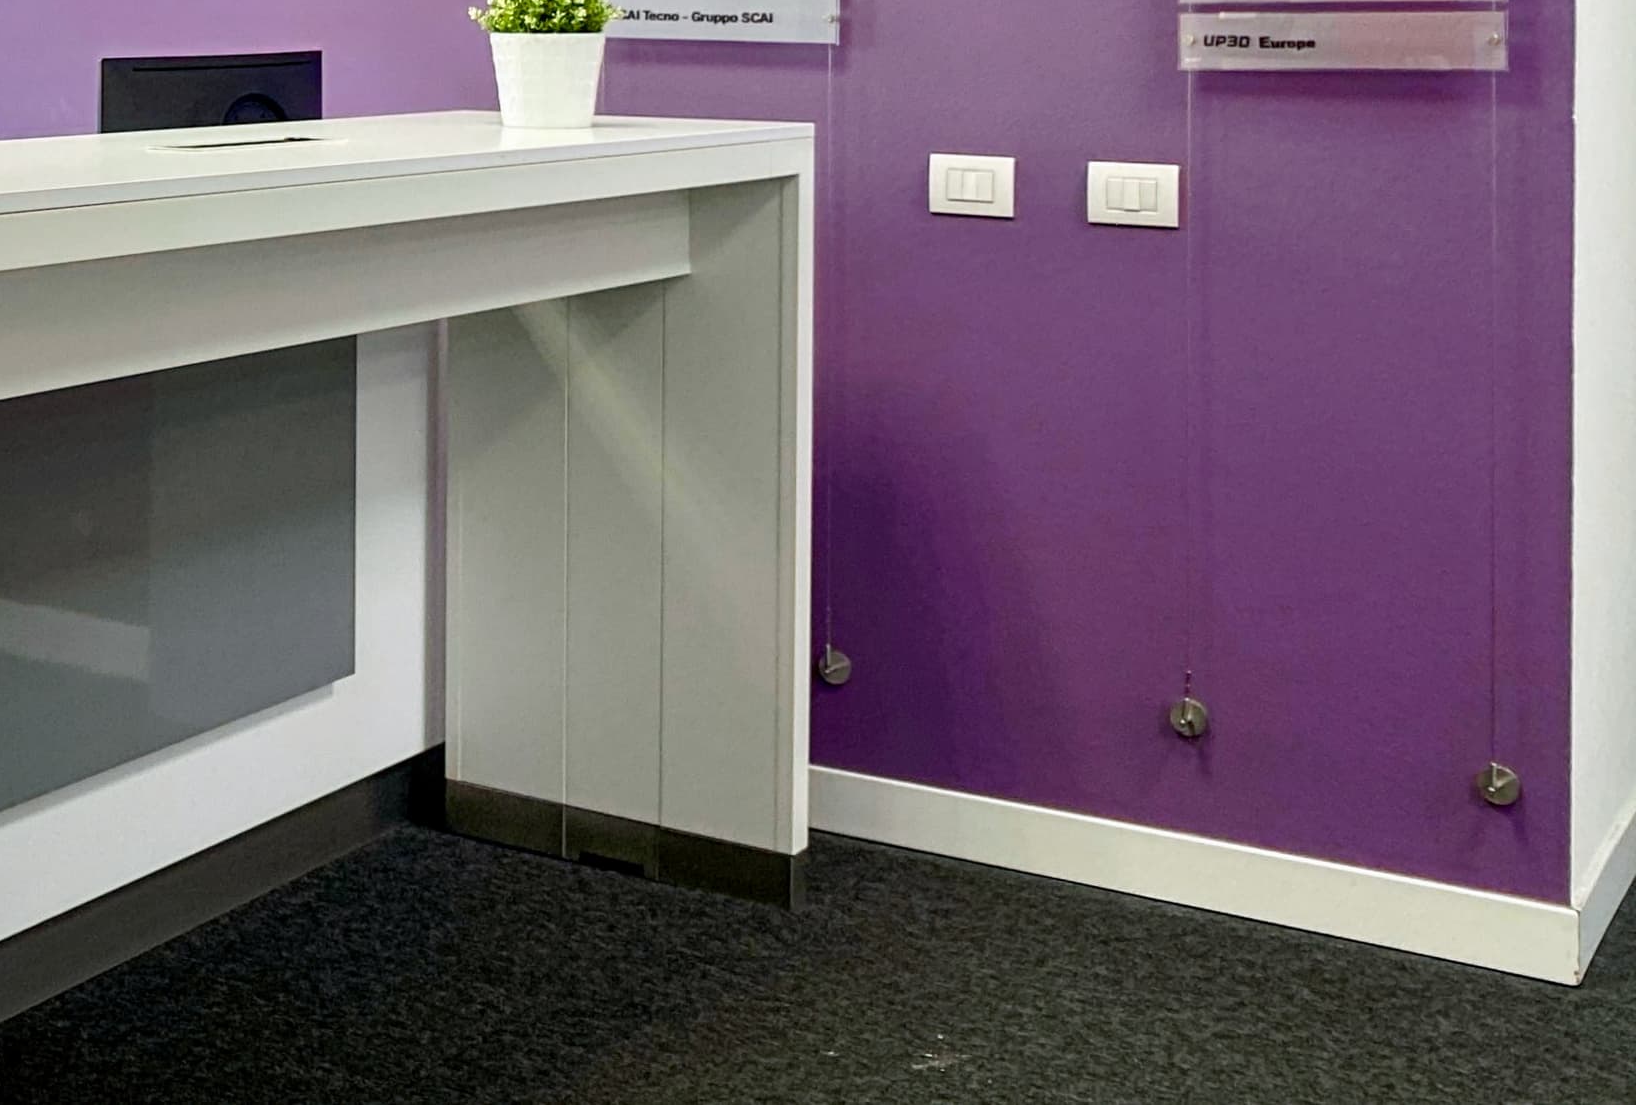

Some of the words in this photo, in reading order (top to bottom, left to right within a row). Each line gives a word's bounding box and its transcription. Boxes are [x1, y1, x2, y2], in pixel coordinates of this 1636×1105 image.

[643, 10, 679, 21] Tecno
[692, 12, 738, 24] Gruppo
[742, 12, 773, 23] SCAI
[1204, 35, 1251, 48] UP3D
[1259, 36, 1316, 50] Europe
